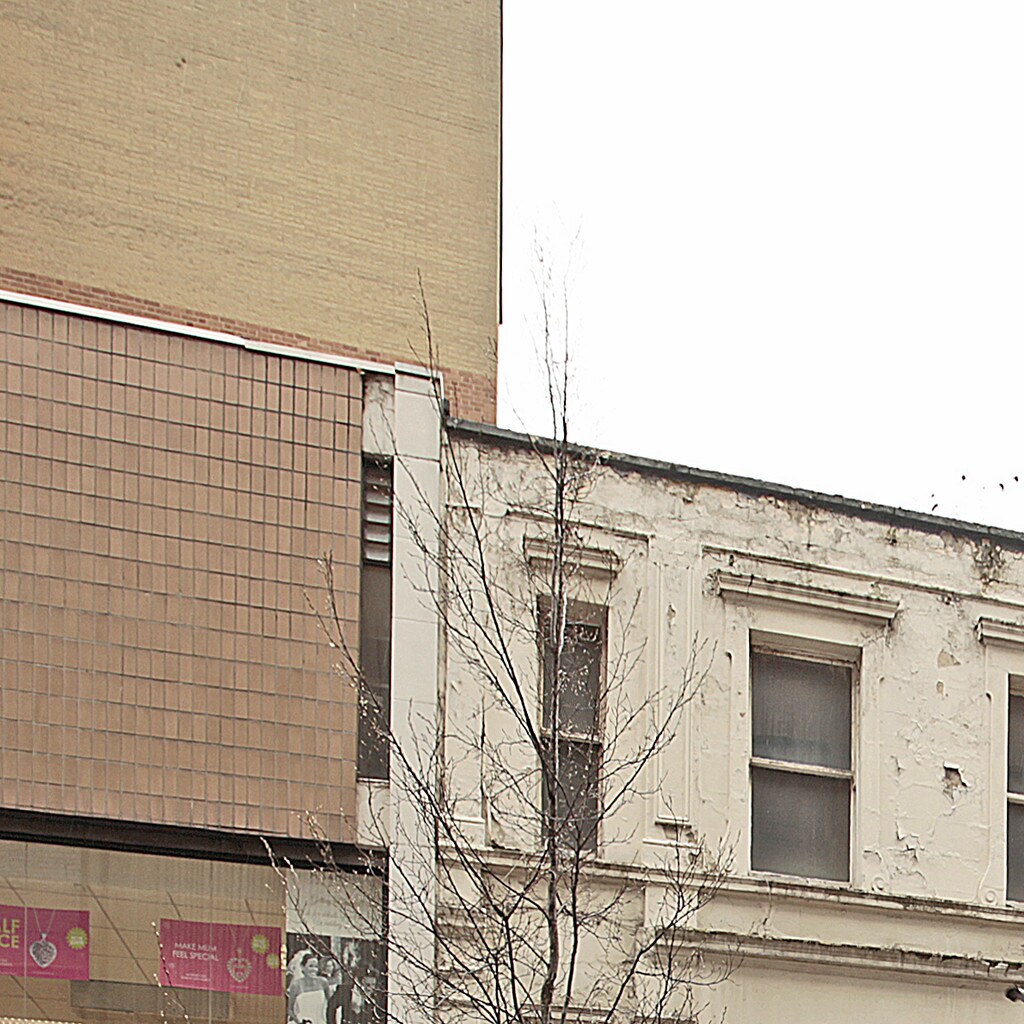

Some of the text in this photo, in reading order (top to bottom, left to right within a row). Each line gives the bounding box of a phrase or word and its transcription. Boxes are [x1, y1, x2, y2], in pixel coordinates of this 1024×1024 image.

[174, 942, 217, 952] MAKE MUM
[172, 950, 219, 962] FEEL SPECIAL
